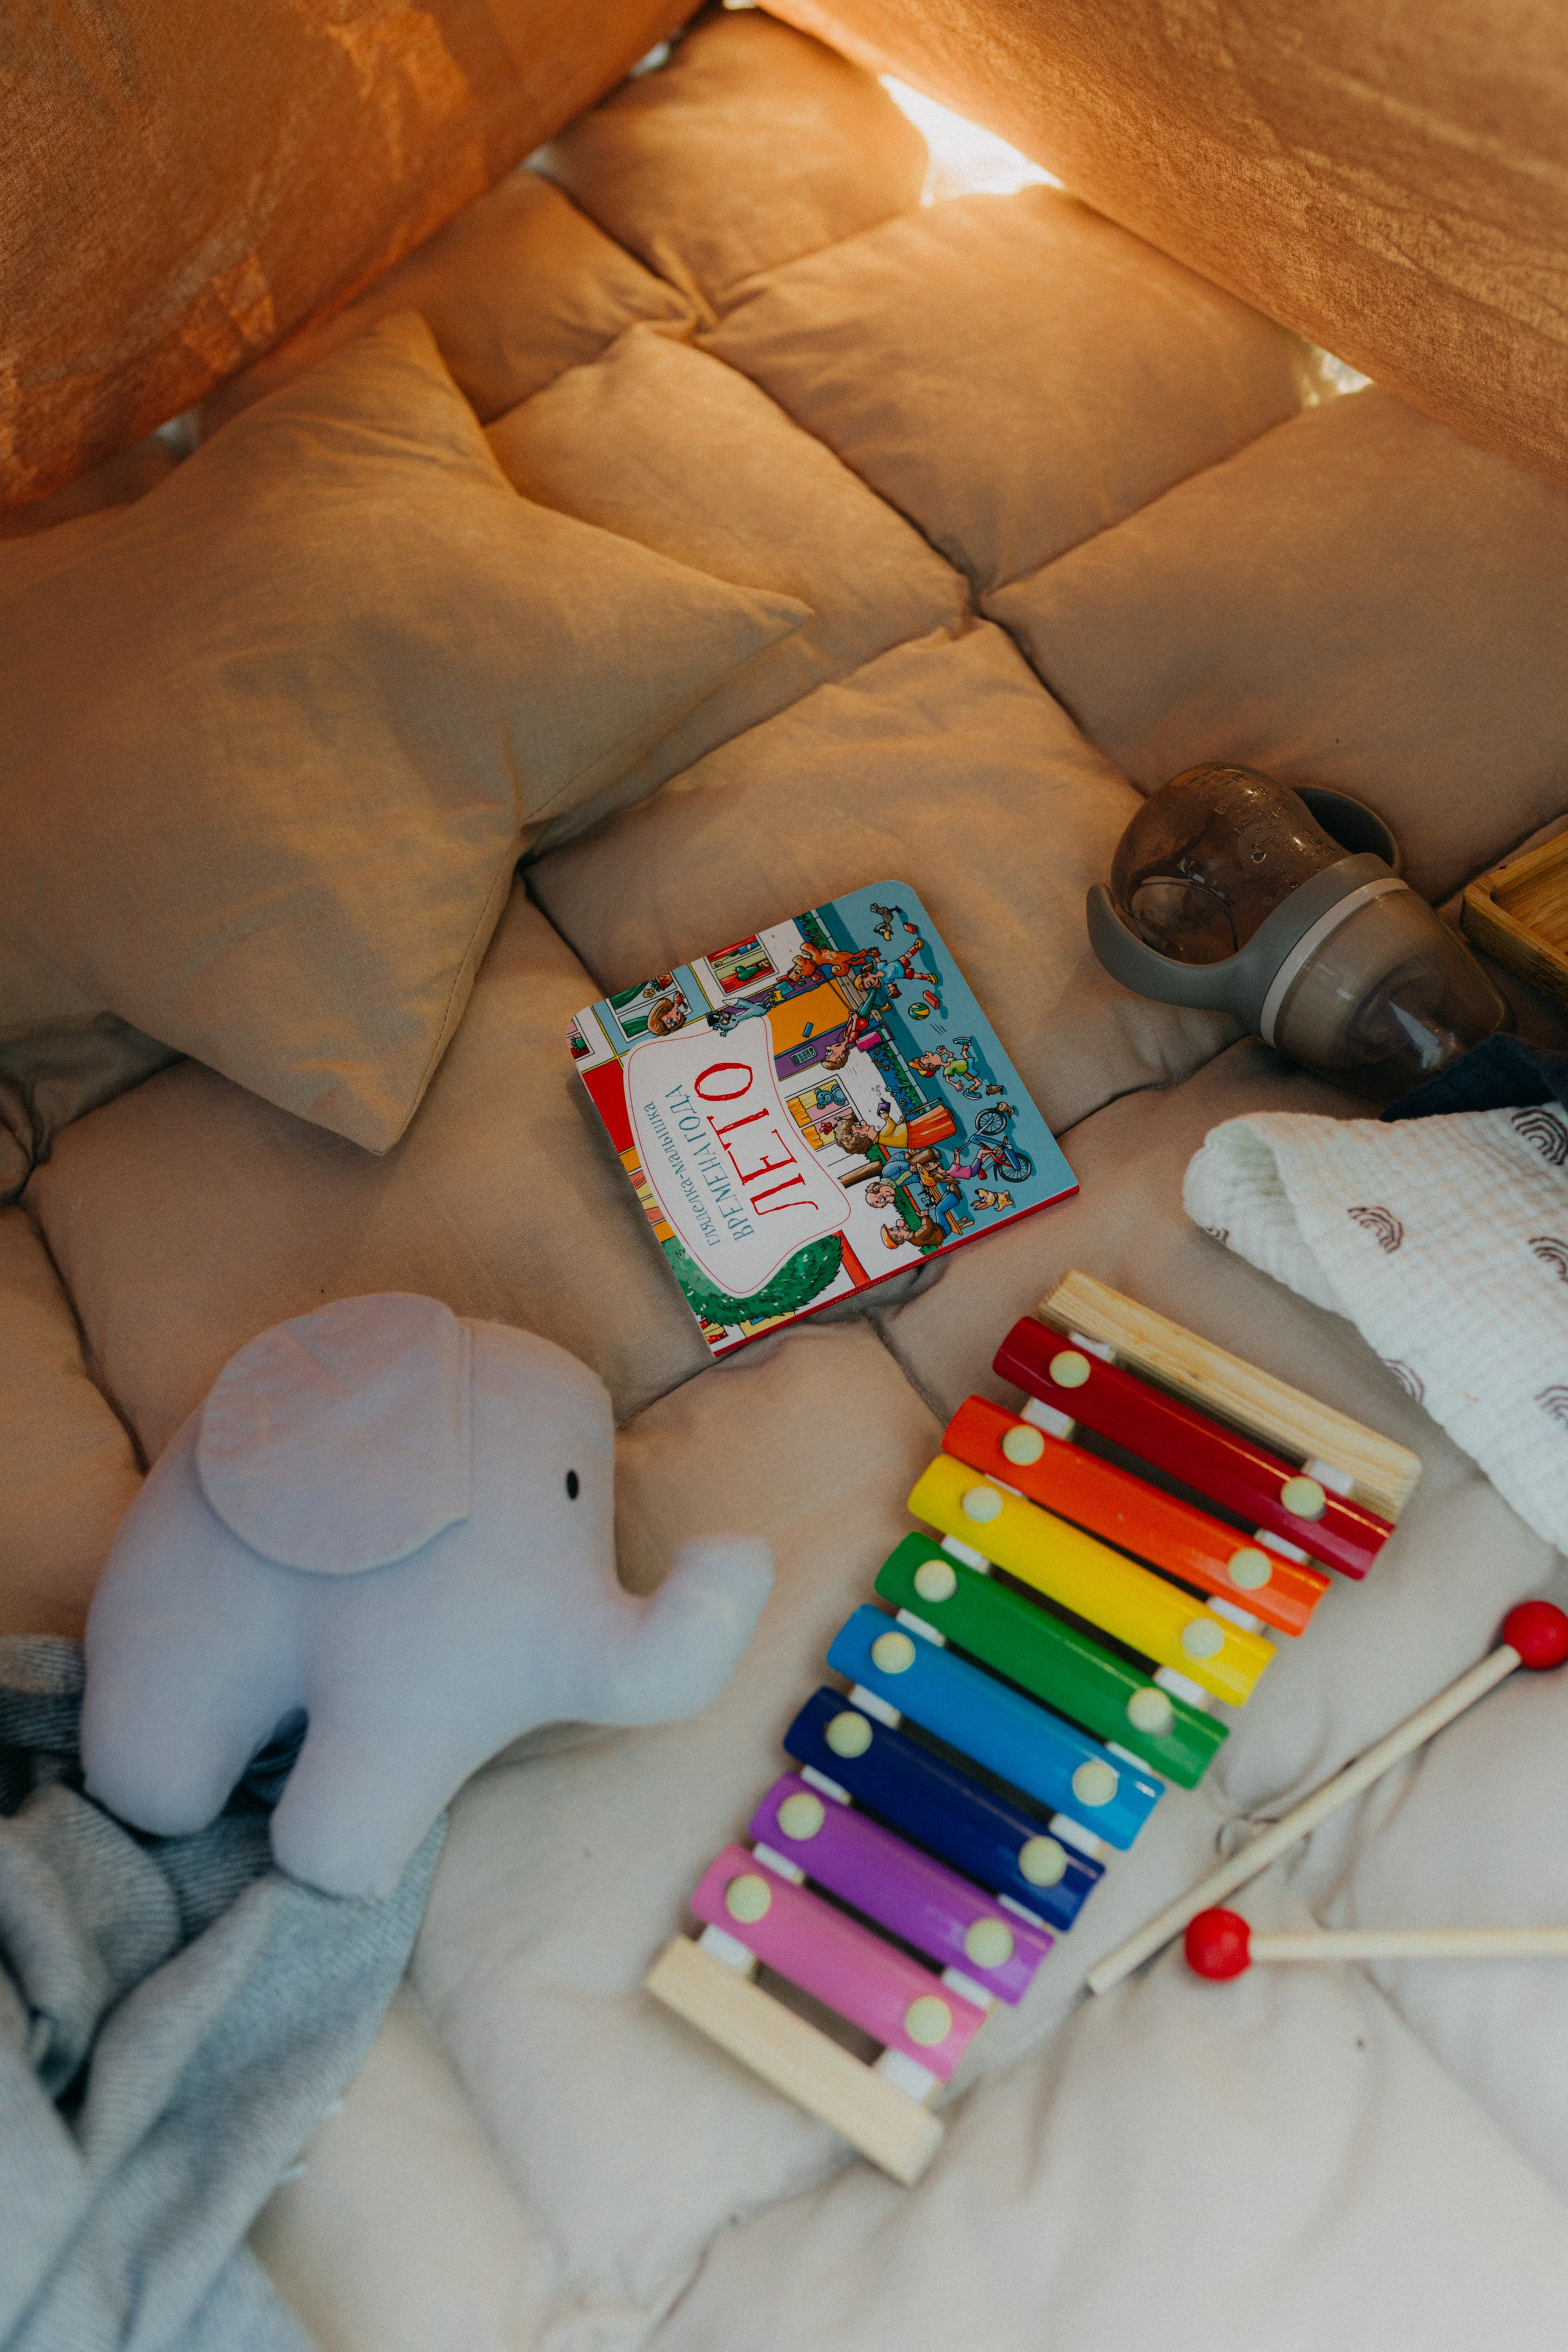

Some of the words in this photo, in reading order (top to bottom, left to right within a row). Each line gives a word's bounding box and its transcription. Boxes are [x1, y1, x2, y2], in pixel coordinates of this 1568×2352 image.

[644, 1101, 720, 1246] гляделка-малышка
[665, 1084, 706, 1144] ГОДА
[694, 1061, 819, 1216] ЛЕТО
[693, 1142, 754, 1241] ВРЕМЕНА
